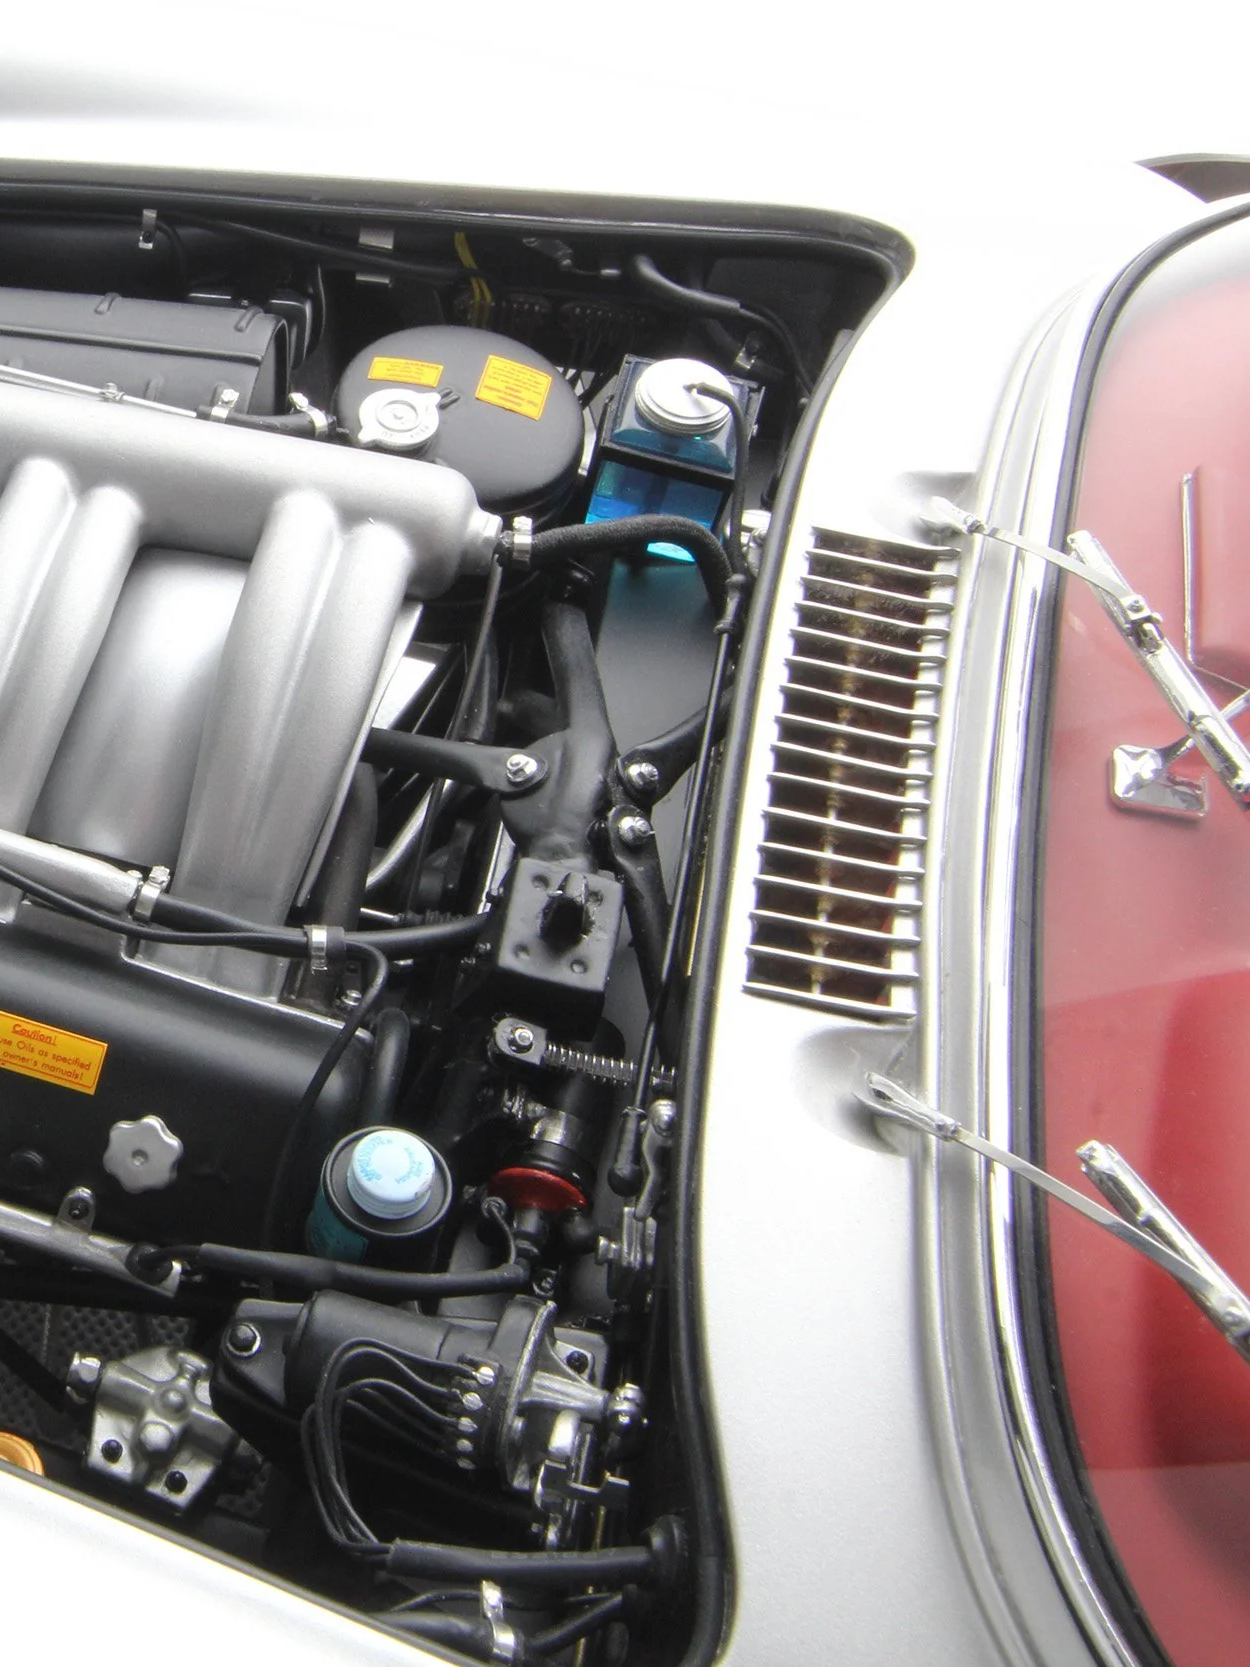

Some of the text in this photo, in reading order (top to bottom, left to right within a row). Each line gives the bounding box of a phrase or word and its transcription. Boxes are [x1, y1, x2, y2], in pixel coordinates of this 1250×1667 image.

[11, 1023, 57, 1044] Caution!
[2, 1051, 38, 1066] owner's
[41, 1062, 83, 1081] manuals!
[16, 1040, 35, 1053] Oils
[52, 1053, 92, 1071] specified
